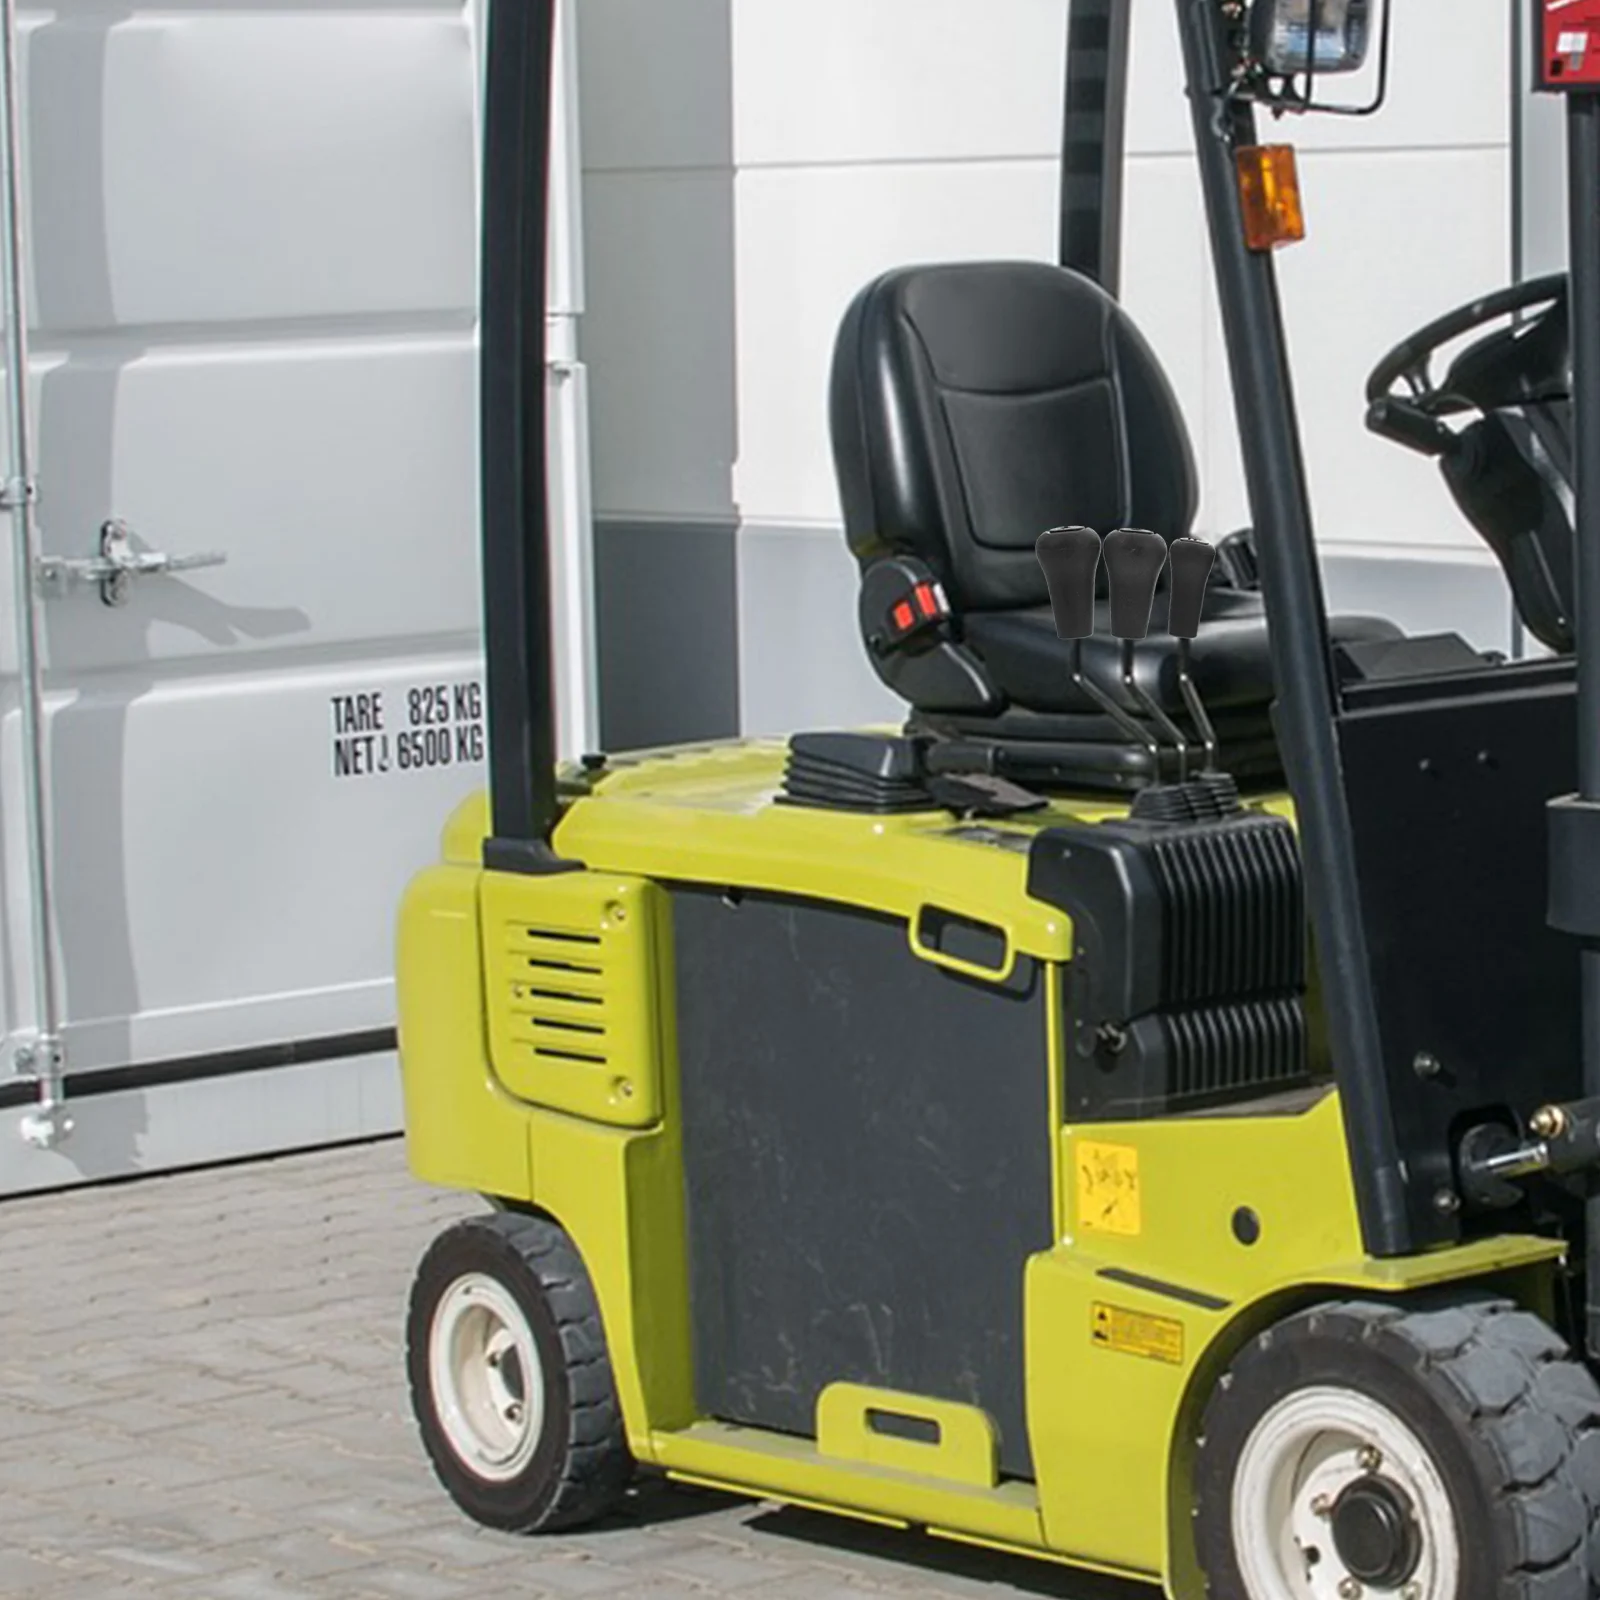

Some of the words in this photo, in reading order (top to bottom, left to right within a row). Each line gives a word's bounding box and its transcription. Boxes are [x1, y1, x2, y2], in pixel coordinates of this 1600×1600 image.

[331, 692, 383, 733] TARE
[408, 685, 449, 726] 825
[454, 681, 481, 721] KG
[397, 728, 451, 769] 6500
[456, 724, 484, 763] KG
